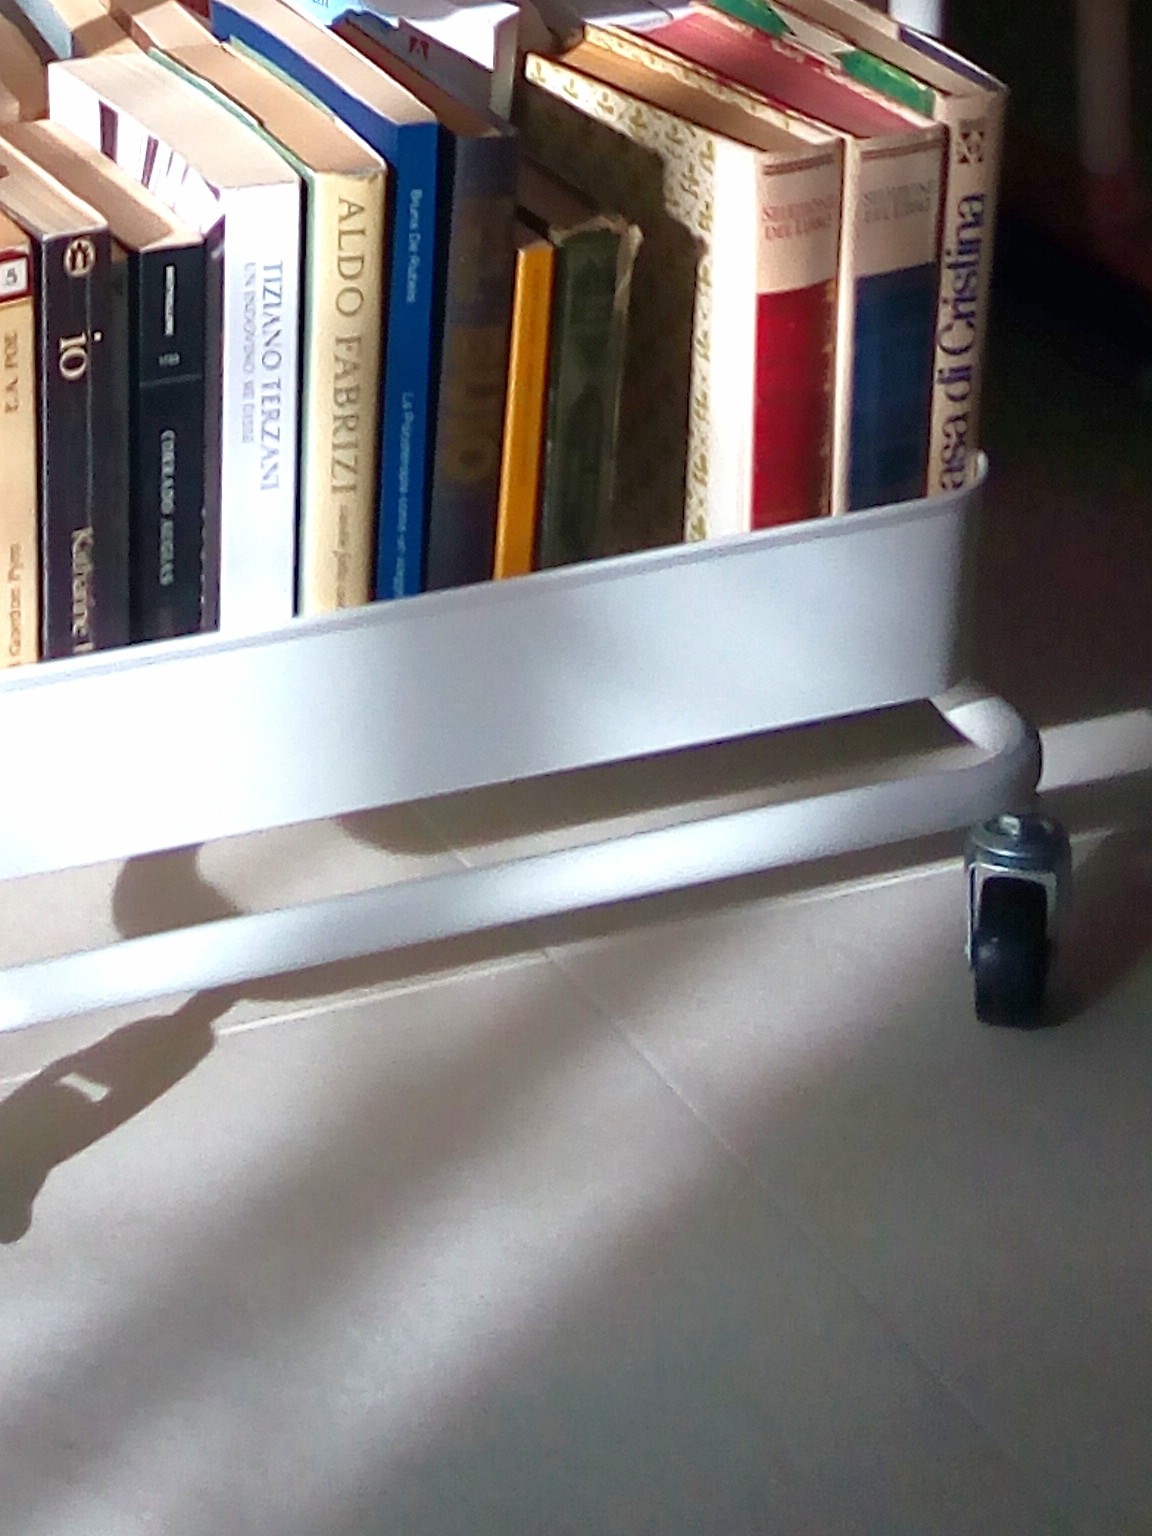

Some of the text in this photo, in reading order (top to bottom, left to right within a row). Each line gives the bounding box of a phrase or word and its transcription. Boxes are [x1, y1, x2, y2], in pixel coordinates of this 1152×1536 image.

[5, 266, 19, 288] 5
[335, 197, 367, 317] ALDO
[4, 331, 19, 370] POE
[260, 260, 284, 491] TIZIANO TERZANI
[936, 193, 986, 490] asa di Cristina
[331, 335, 363, 494] FABRIZI
